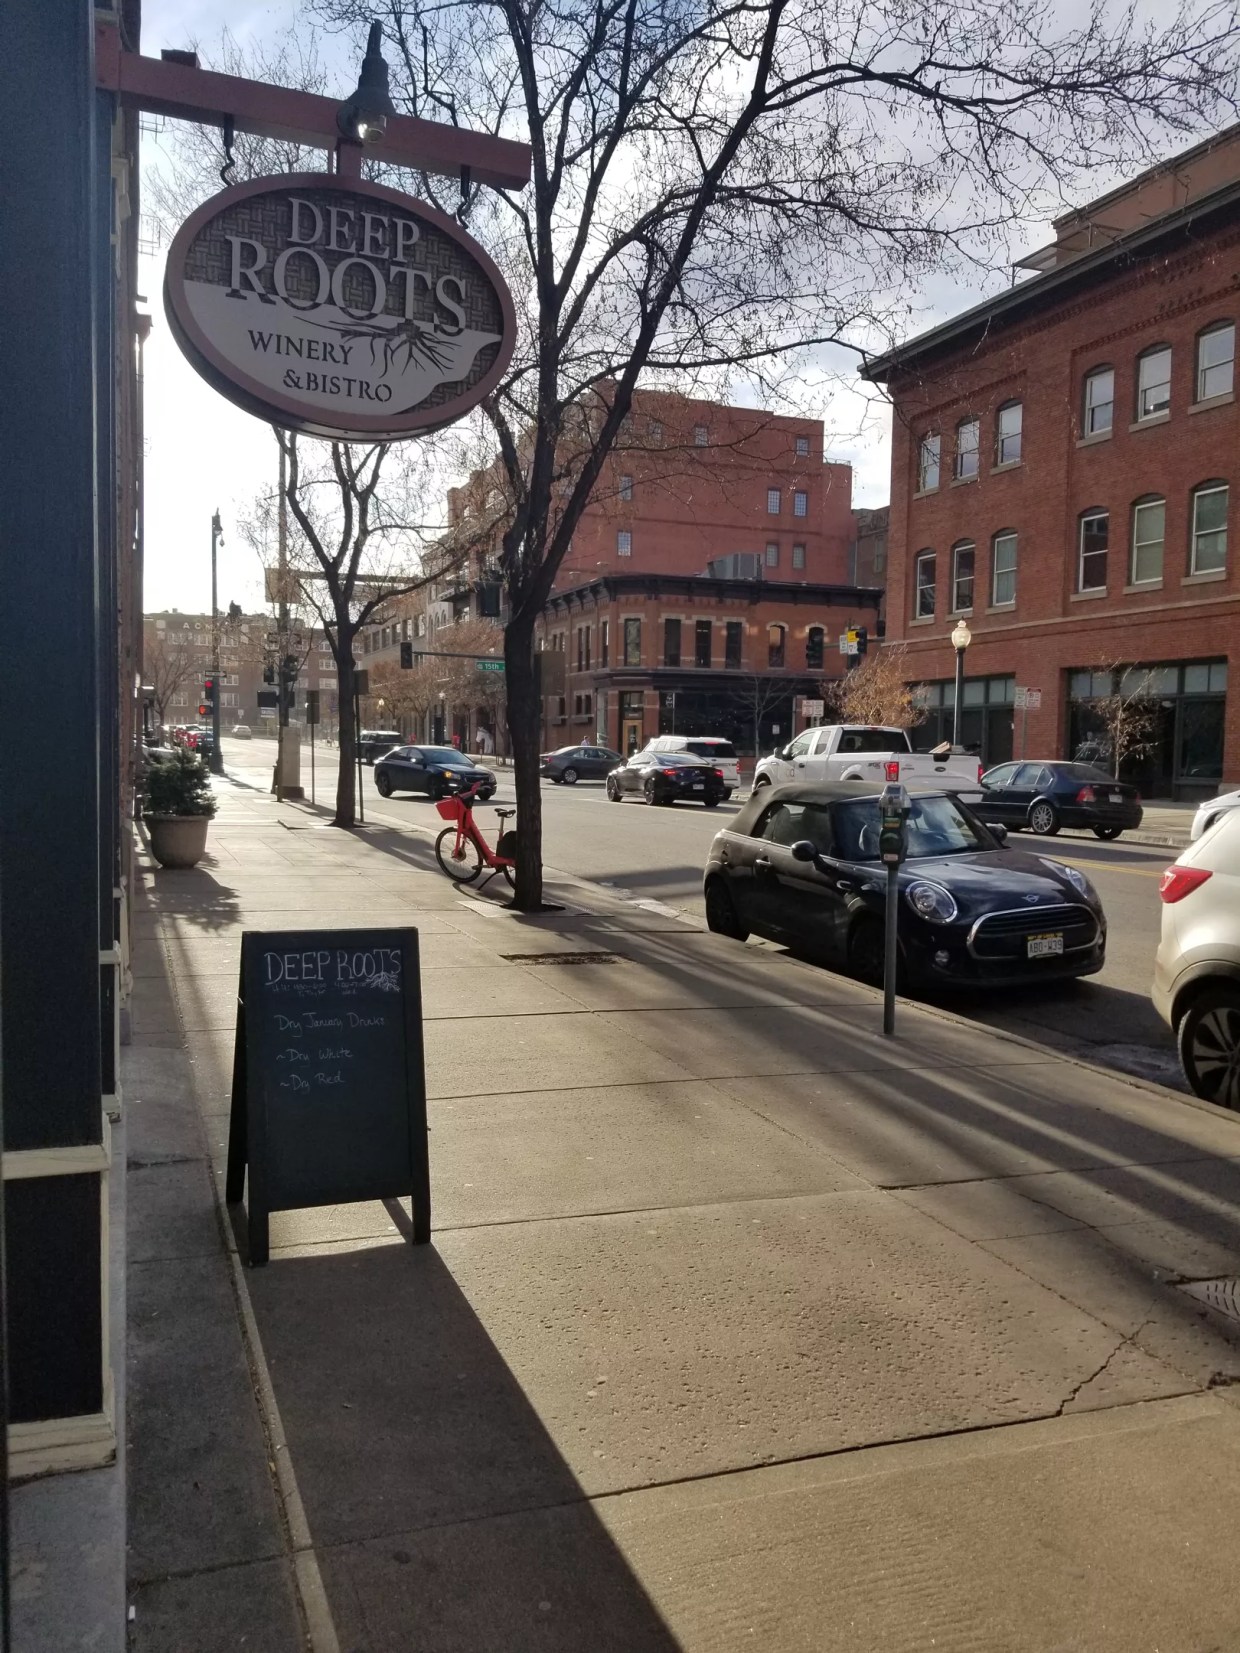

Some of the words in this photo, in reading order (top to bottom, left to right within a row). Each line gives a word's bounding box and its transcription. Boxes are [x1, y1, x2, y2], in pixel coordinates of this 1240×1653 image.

[288, 198, 420, 263] DEEP
[225, 235, 467, 337] ROOTS
[248, 329, 354, 365] WINERY
[264, 951, 331, 985] DEEP
[337, 949, 402, 980] ROOTS
[274, 1013, 303, 1037] Dry
[302, 1012, 343, 1031] January
[346, 1012, 385, 1028] Drinks
[318, 1047, 354, 1060] White
[314, 1070, 345, 1084] Red
